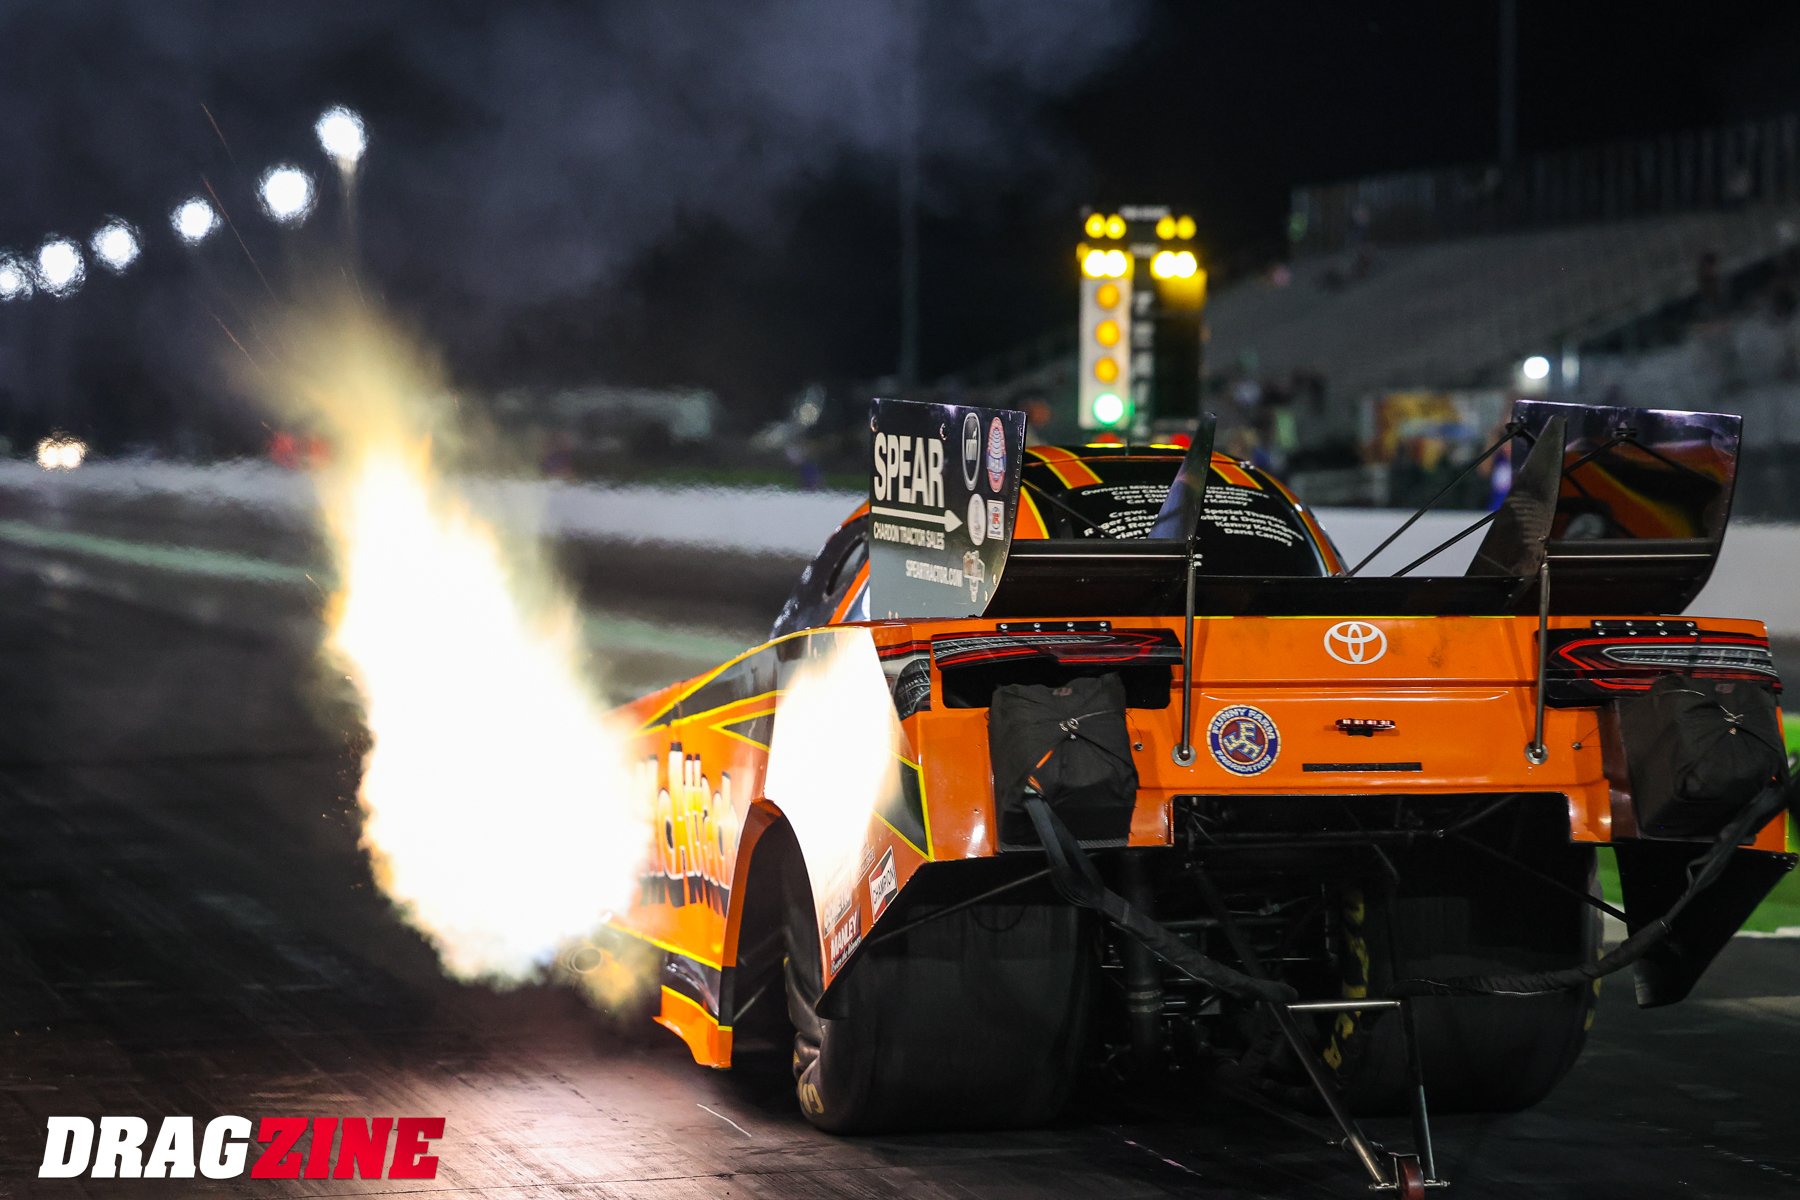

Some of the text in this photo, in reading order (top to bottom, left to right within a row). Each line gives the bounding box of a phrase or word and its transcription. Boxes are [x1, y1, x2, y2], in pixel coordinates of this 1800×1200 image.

[874, 431, 944, 508] SPEAR
[1200, 514, 1228, 522] obby
[1204, 508, 1243, 516] Special
[1214, 521, 1251, 530] Kenny
[1223, 528, 1254, 536] Dane
[926, 530, 946, 551] SALES
[1212, 708, 1276, 740] FUNNY FARM
[1215, 749, 1272, 772] FABRICATION
[830, 910, 858, 960] MANLEY
